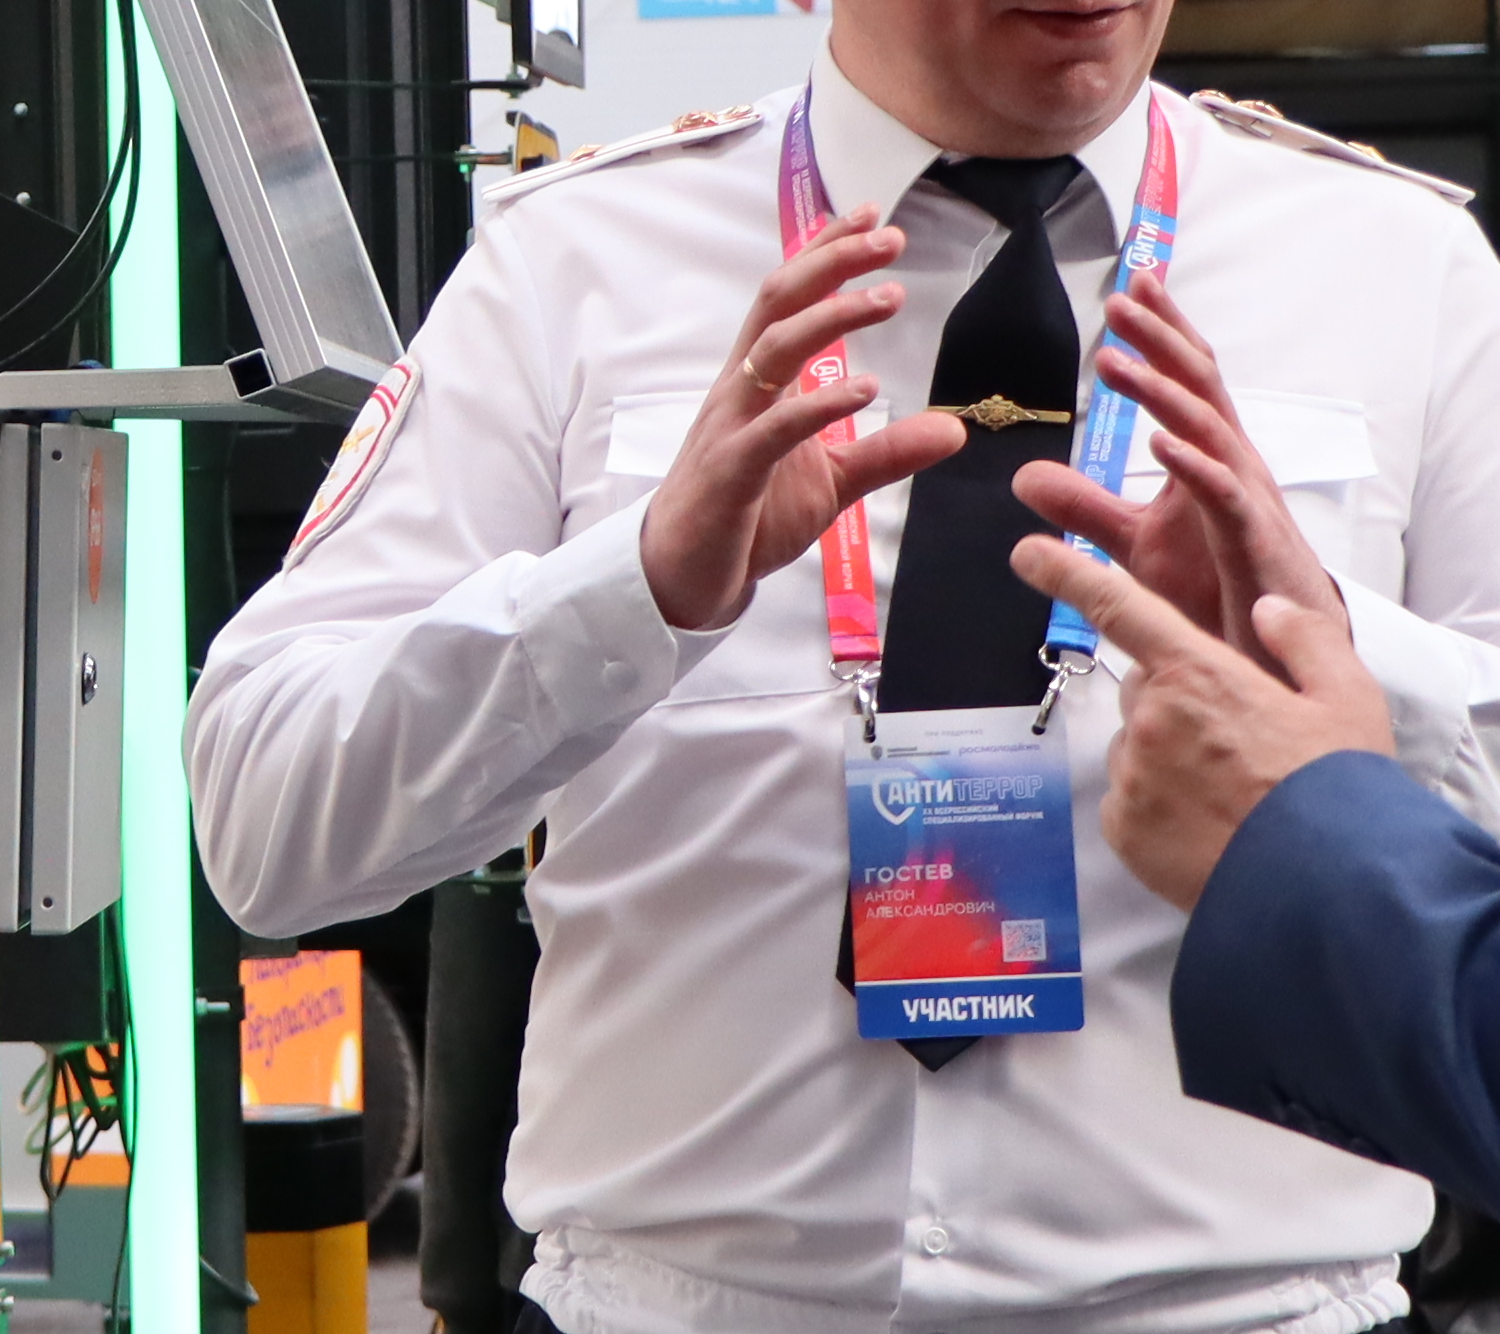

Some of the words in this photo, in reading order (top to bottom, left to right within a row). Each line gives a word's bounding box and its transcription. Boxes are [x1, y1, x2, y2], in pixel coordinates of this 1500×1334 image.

[887, 774, 1044, 806] АНТИТЕРРОР
[934, 803, 999, 815] ВСЕРОССИЙСКИЙ
[864, 863, 954, 884] ГОСТЕВ
[864, 889, 915, 903] АНТОН
[866, 901, 996, 919] АЛЕКСАНДРОВИЧ
[902, 994, 1036, 1023] УЧАСТНИК
